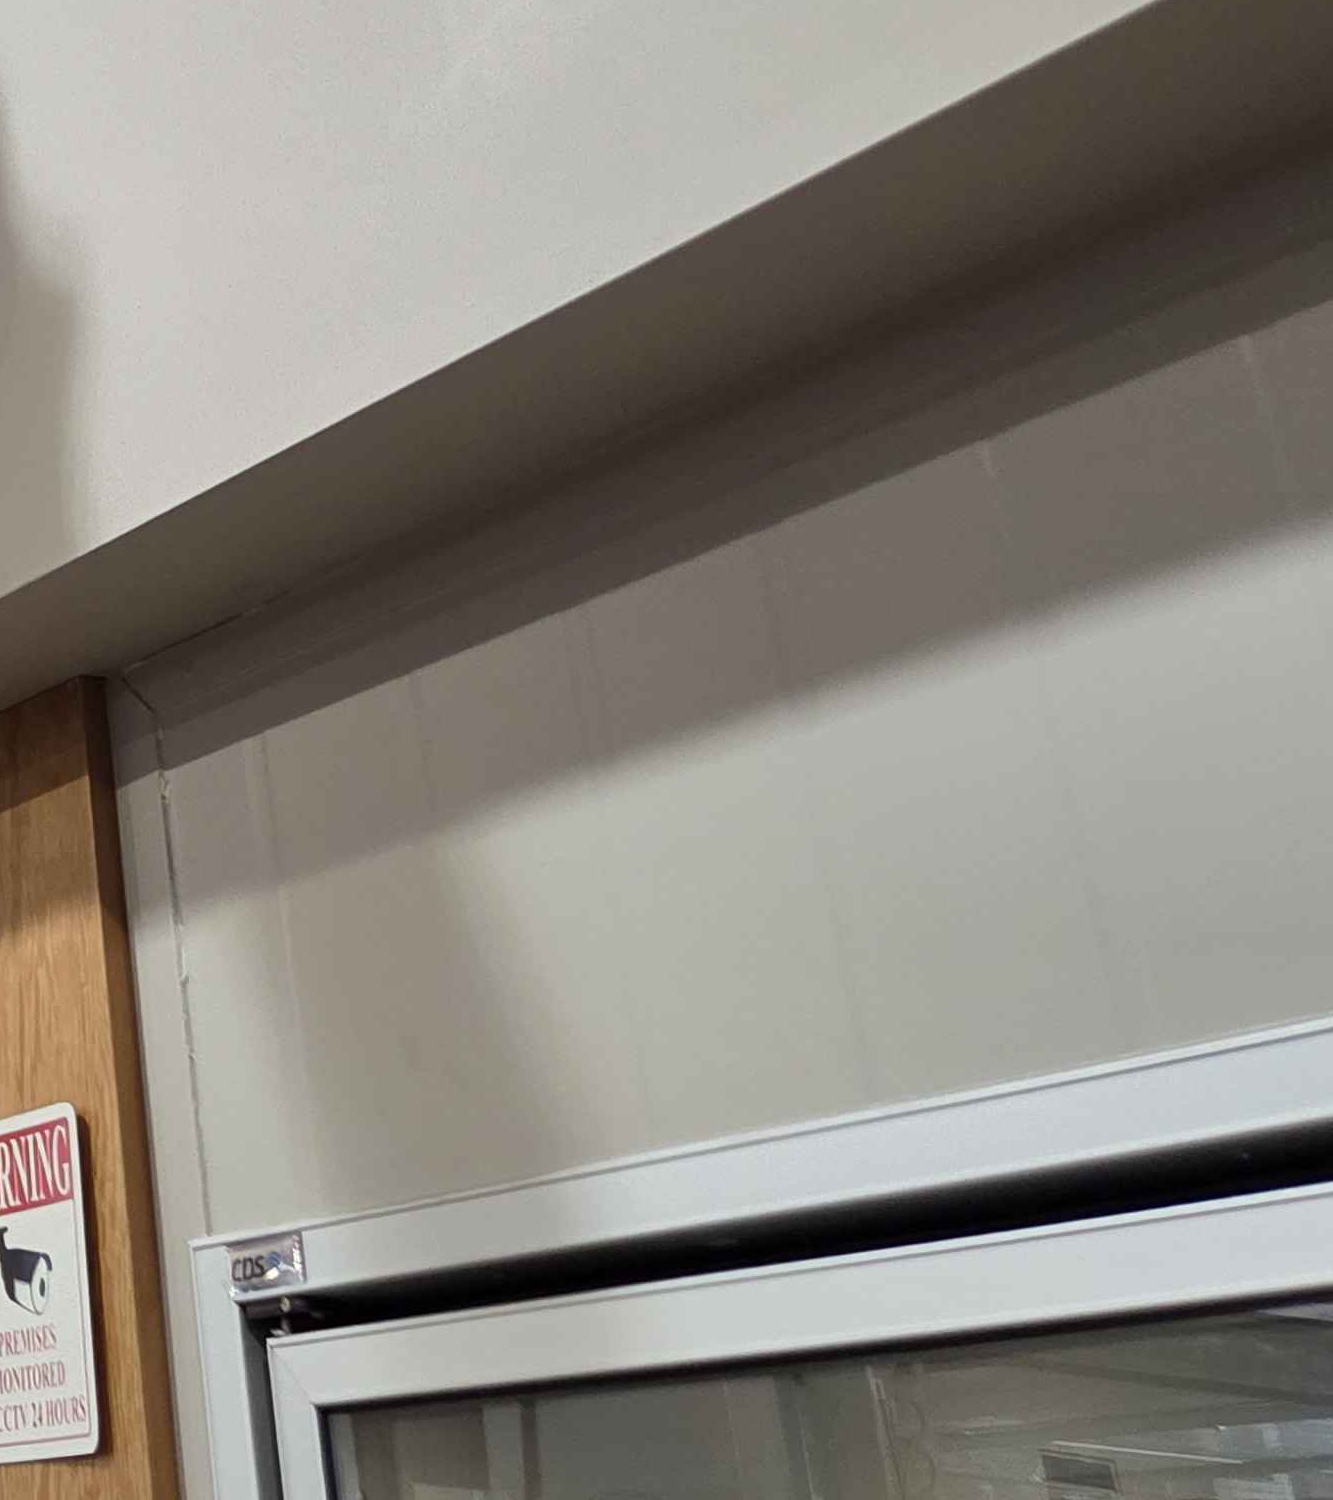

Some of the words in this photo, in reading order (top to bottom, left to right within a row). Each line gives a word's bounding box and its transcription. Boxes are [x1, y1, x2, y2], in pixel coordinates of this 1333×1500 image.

[231, 1255, 266, 1282] CDS
[31, 1401, 44, 1428] 24
[45, 1395, 87, 1427] HOURS
